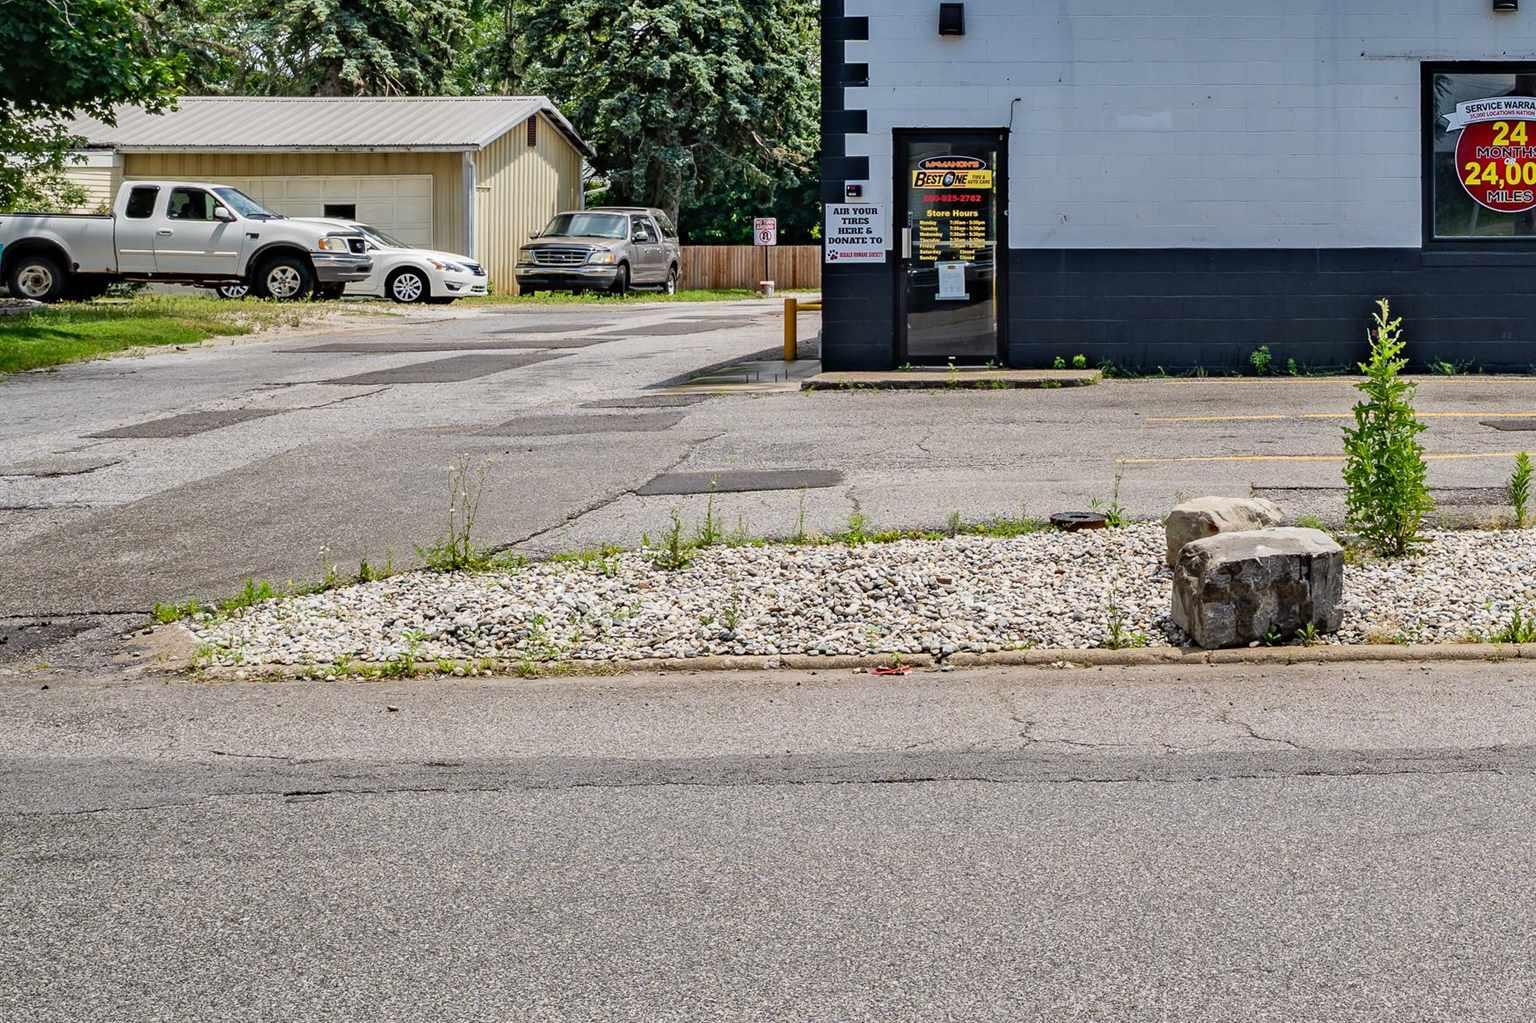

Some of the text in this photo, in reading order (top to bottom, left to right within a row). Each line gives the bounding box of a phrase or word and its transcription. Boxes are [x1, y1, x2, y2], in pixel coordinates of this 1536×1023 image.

[1465, 101, 1502, 114] SERVICE
[1492, 121, 1528, 146] 24
[1487, 190, 1534, 203] MILES
[833, 207, 878, 215] AIR YOUR
[927, 209, 979, 217] Store Hours
[841, 217, 869, 225] TIRES
[838, 227, 873, 235] HERE &
[828, 237, 882, 245] DONATE TO
